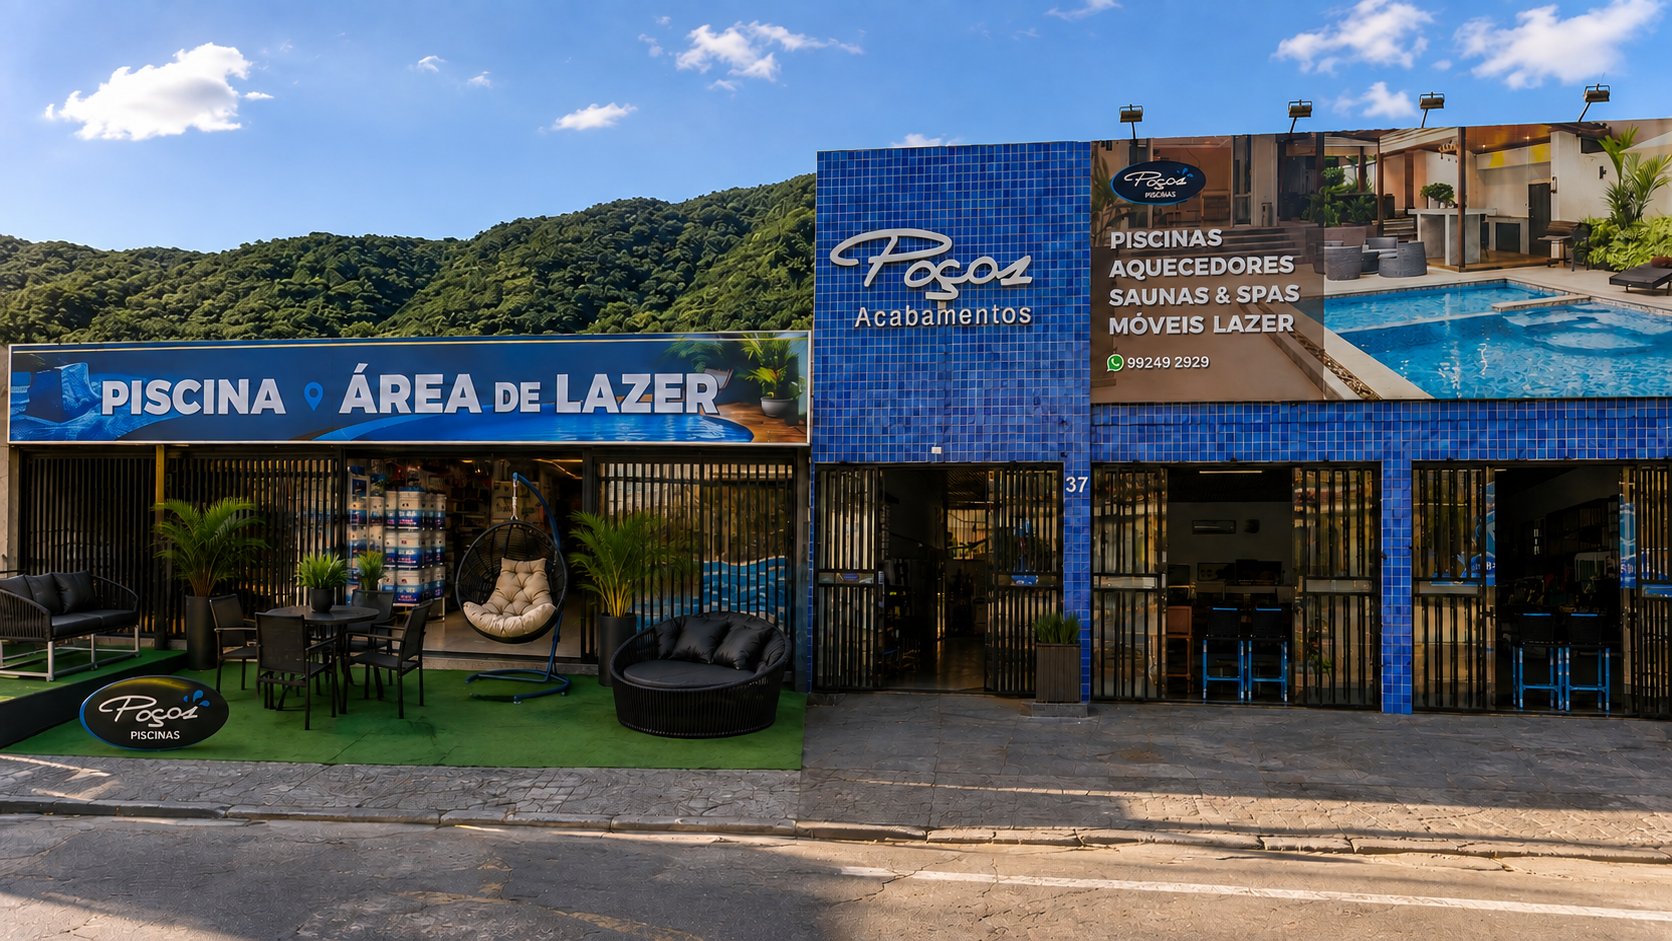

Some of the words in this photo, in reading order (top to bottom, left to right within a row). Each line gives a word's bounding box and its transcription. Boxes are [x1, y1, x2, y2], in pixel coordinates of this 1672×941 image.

[1110, 229, 1223, 249] PISCINAS
[1109, 256, 1295, 280] AQUECEDORES
[1109, 287, 1209, 306] SAUNAS
[1215, 287, 1231, 304] &
[1236, 285, 1300, 303] SPAS
[855, 305, 1032, 328] Acabamentos
[1109, 313, 1205, 335] MÓVEIS
[1213, 314, 1294, 333] LAZER
[1127, 357, 1171, 369] 99249
[1174, 356, 1210, 368] 2929
[102, 378, 286, 415] PISCINA
[339, 363, 482, 414] ÁREA
[494, 382, 541, 412] DE
[556, 373, 720, 414] LAZER
[1066, 476, 1088, 493] 37
[130, 730, 180, 740] PISCINAS
